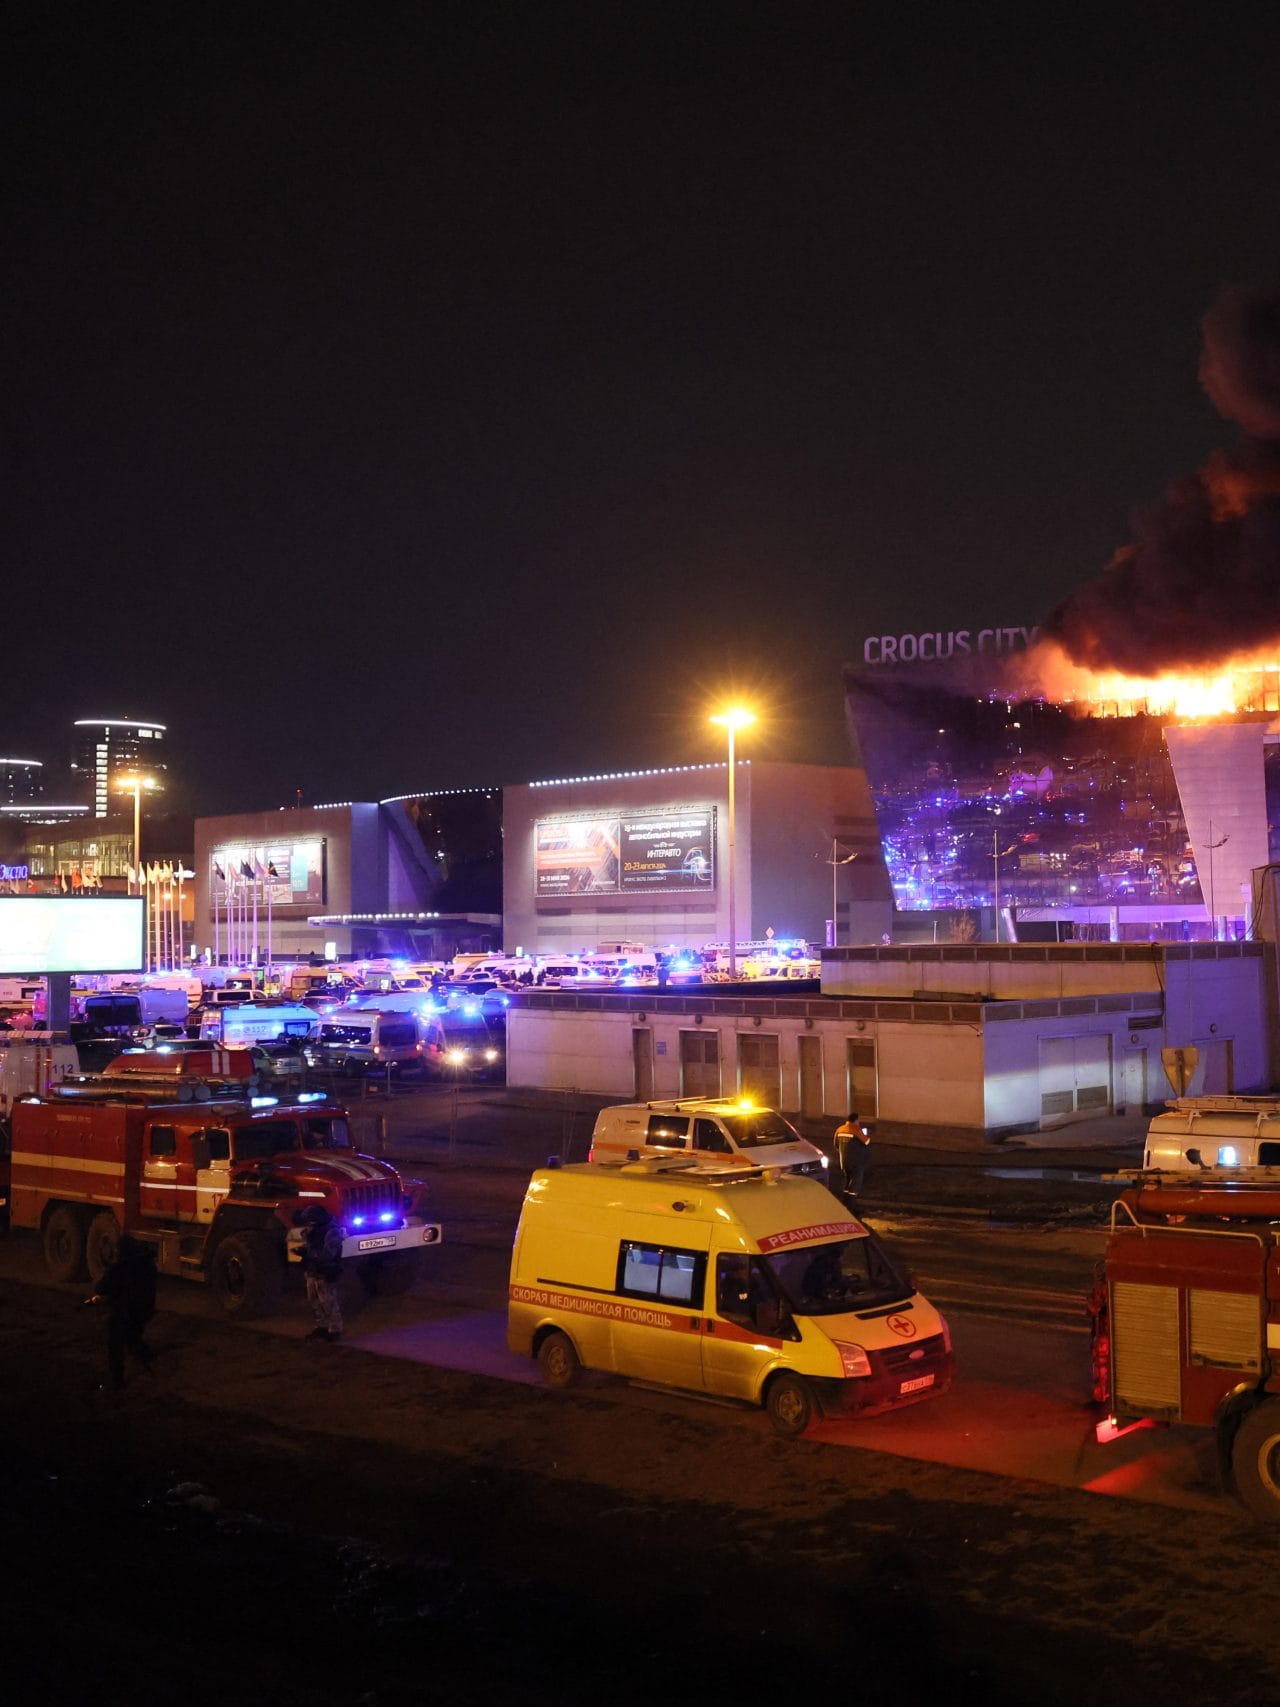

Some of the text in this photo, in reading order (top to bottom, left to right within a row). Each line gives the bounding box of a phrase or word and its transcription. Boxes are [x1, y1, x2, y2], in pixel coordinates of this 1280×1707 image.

[864, 626, 1040, 663] CROCUS CITY
[52, 1063, 74, 1074] 112
[768, 1223, 858, 1247] РЕАНИМАЦИЯ
[512, 1286, 672, 1328] СКОРАЯ МЕДИЦИНСКАЯ ПОМОЩЬ
